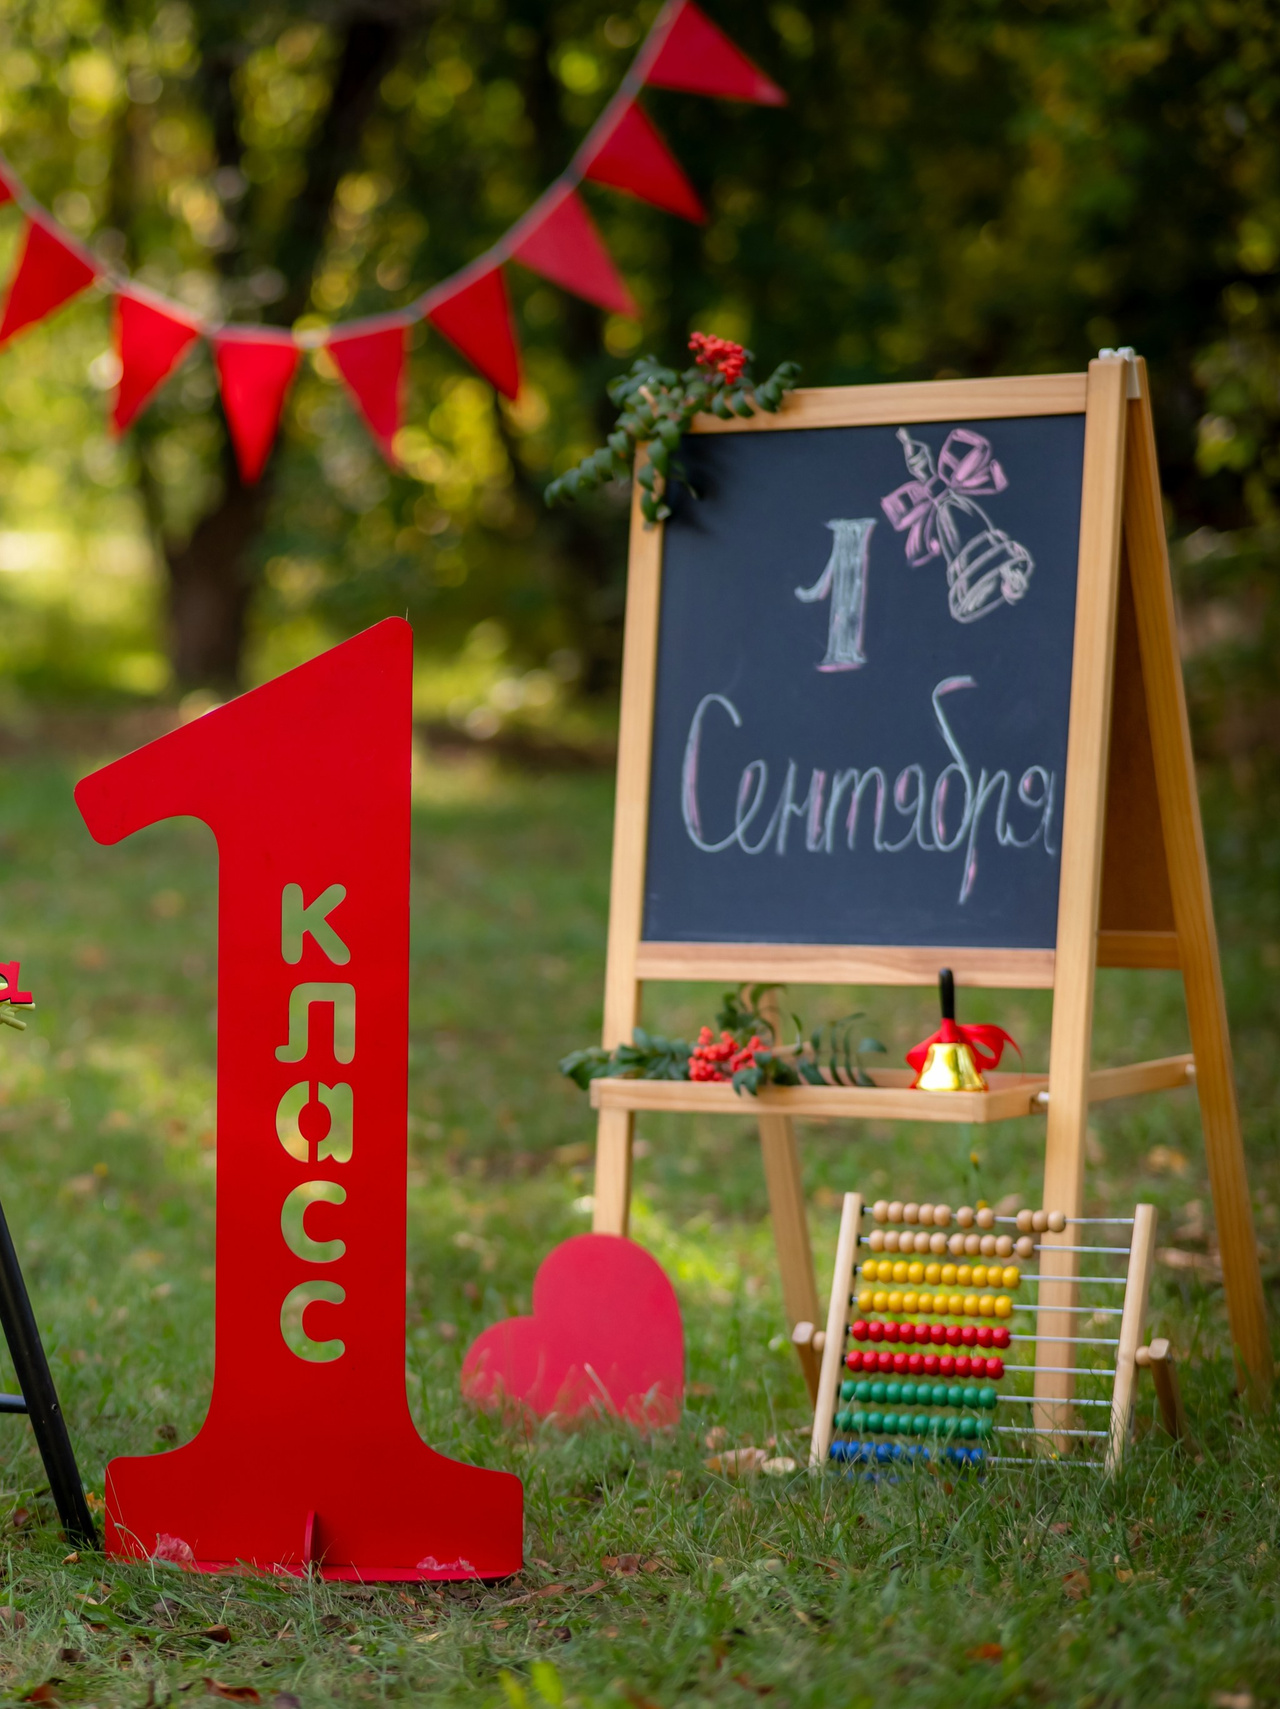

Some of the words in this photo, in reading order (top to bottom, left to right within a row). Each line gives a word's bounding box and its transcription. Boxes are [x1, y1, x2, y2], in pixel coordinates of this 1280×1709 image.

[795, 517, 877, 672] 1
[681, 675, 1055, 903] Сентября
[74, 615, 523, 1582] 1
